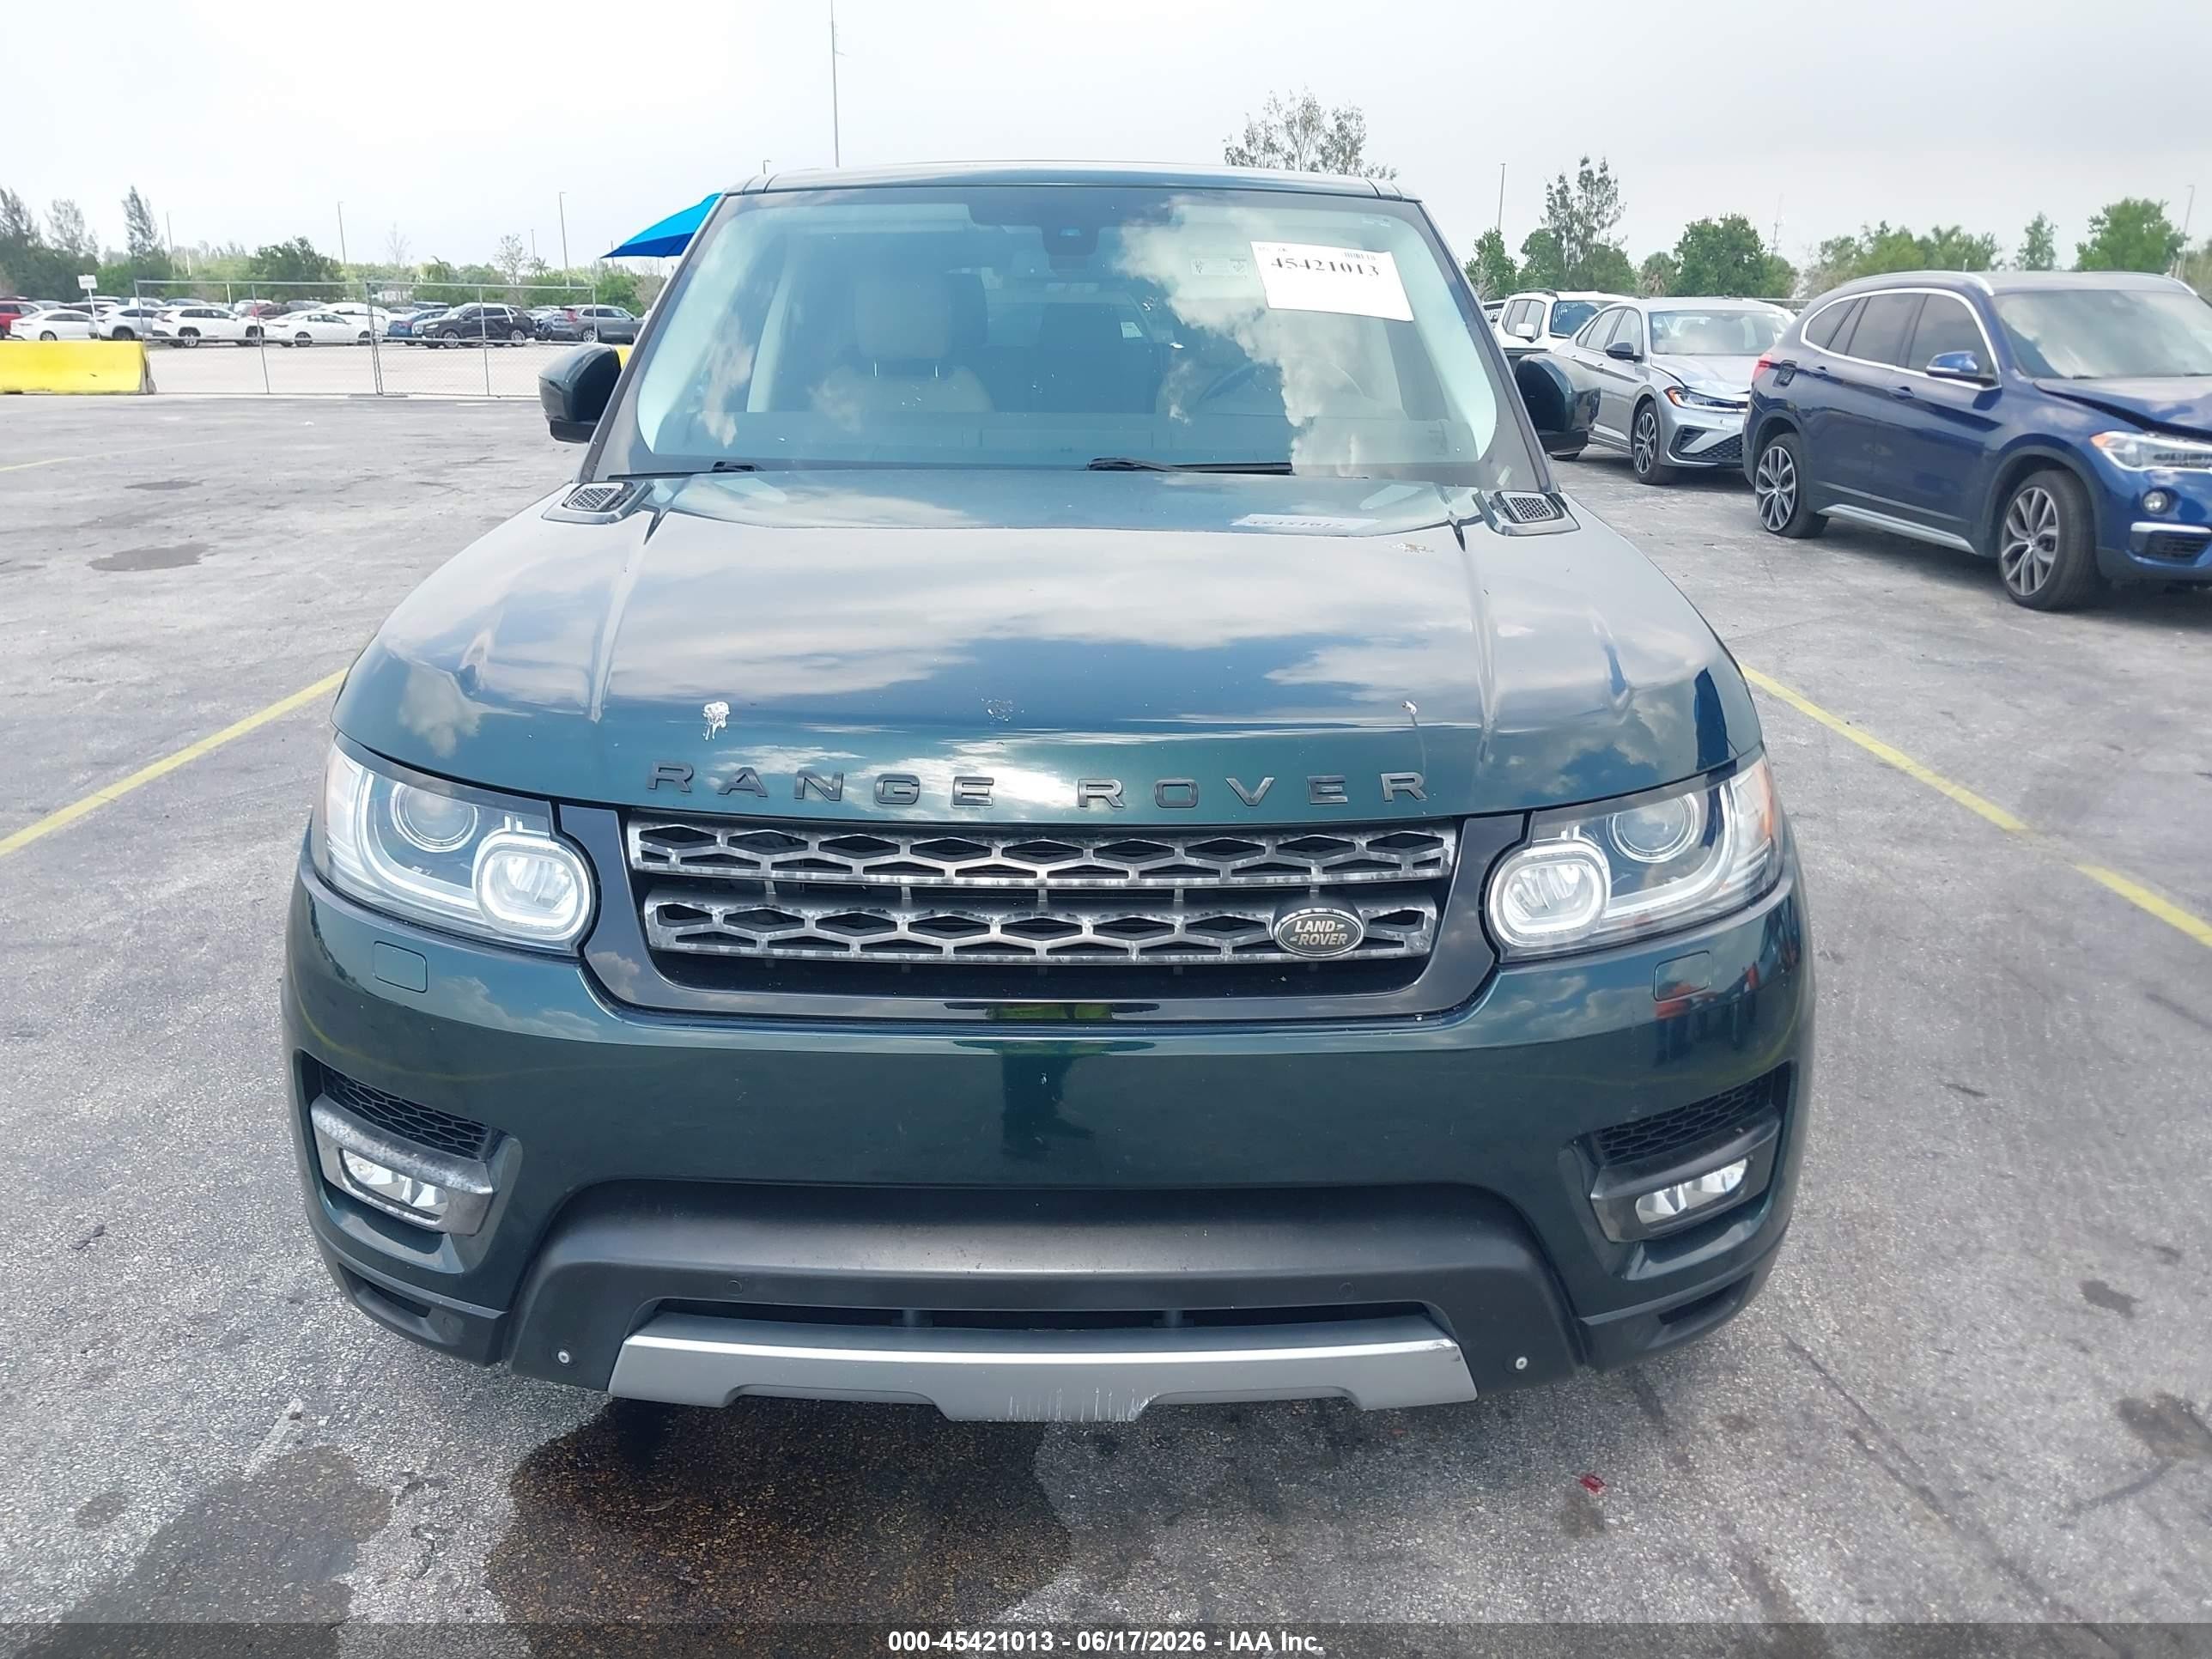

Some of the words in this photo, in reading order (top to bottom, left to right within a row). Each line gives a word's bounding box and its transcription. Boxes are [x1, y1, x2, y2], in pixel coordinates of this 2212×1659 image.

[1271, 257, 1380, 276] 45421013
[646, 761, 995, 807] RANGE
[1078, 771, 1429, 808] ROVER
[1294, 920, 1336, 933] LAND
[1297, 933, 1348, 945] ROVER
